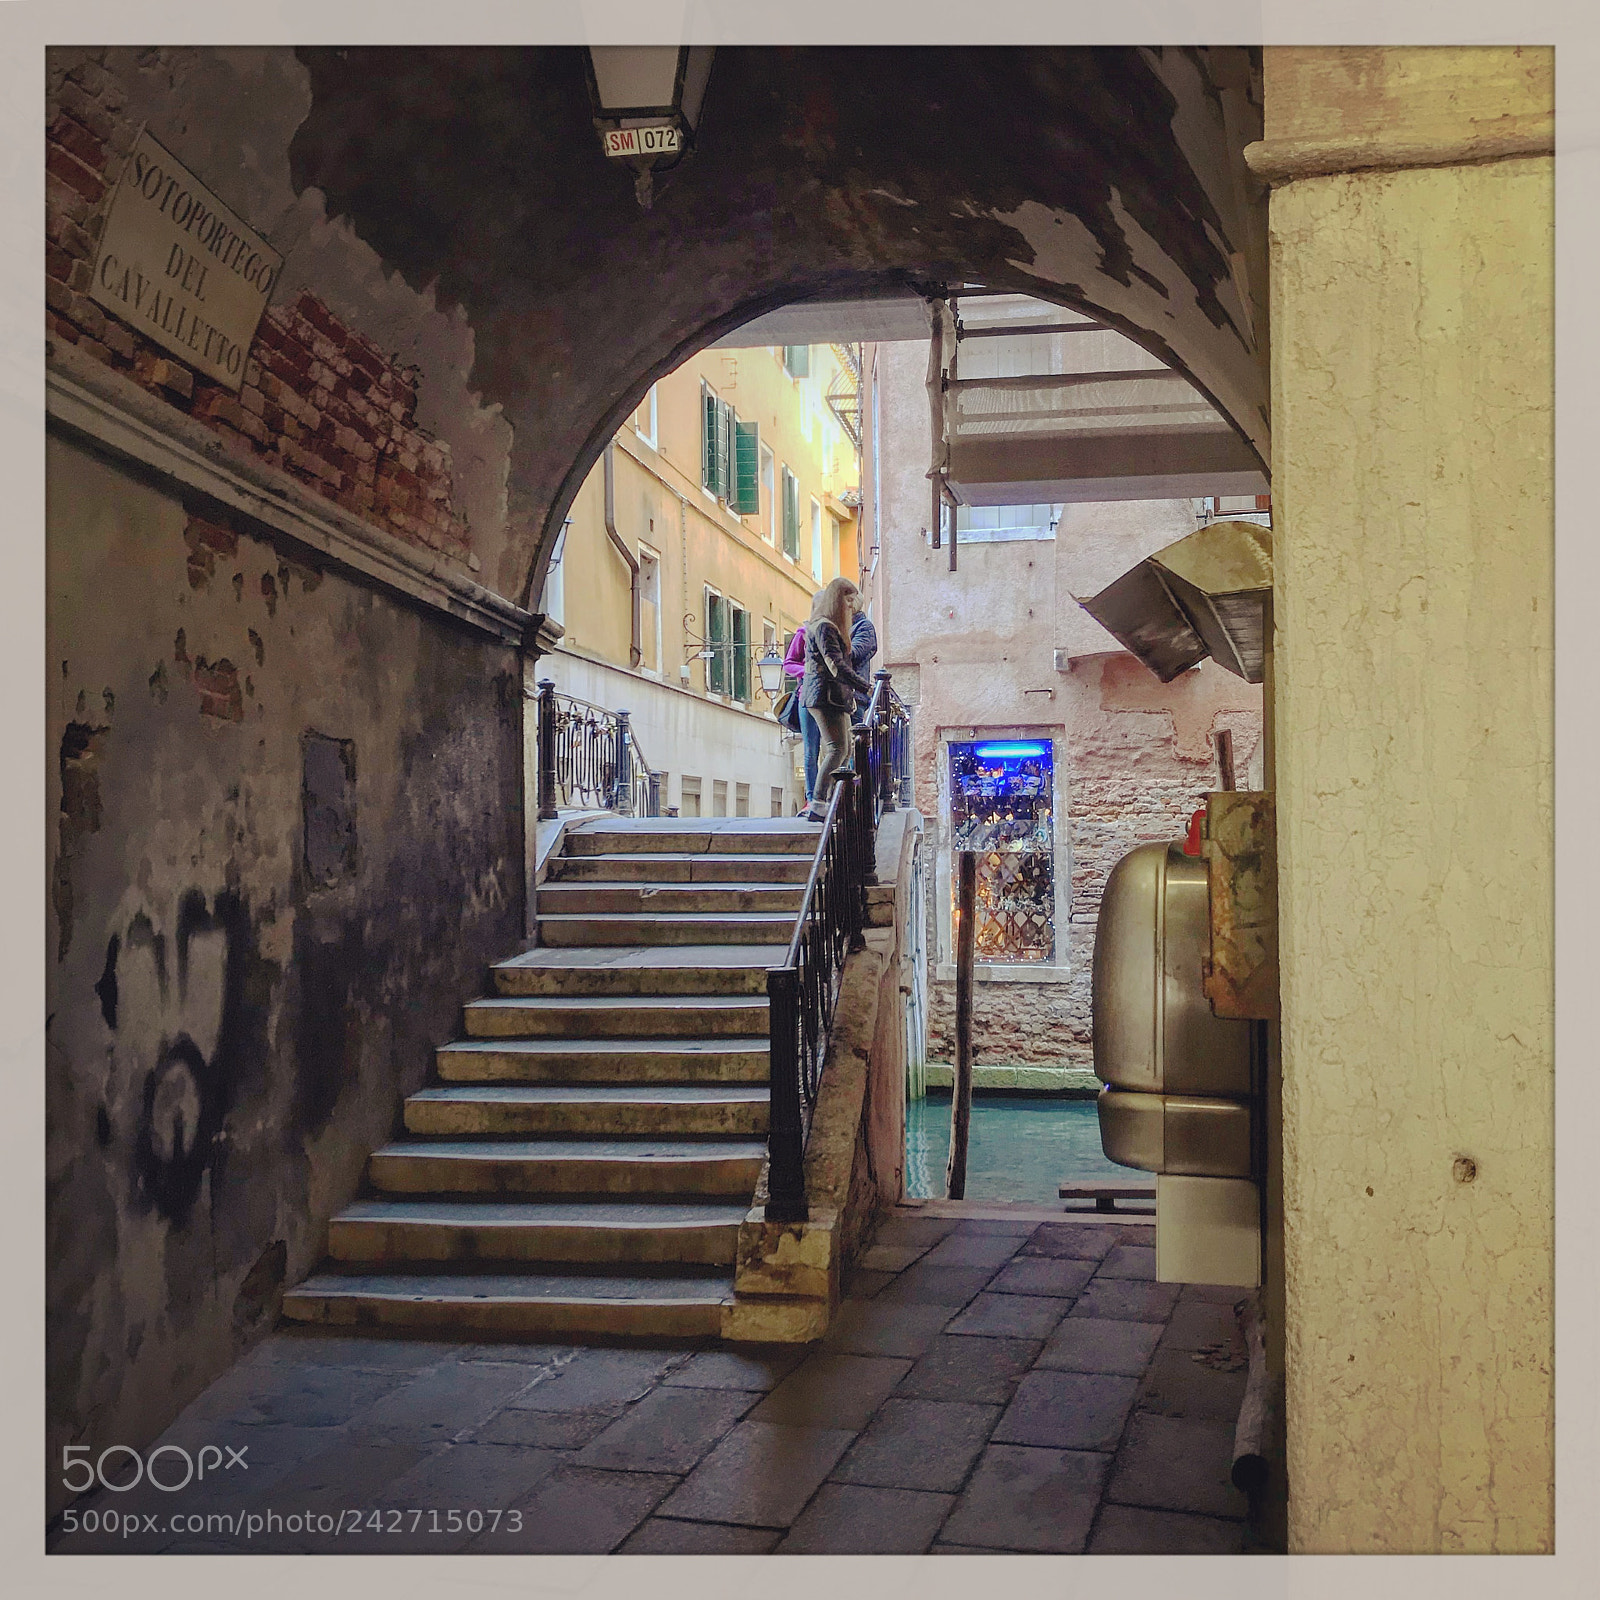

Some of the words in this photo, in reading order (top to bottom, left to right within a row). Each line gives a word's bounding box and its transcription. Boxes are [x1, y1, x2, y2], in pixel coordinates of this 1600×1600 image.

[610, 133, 634, 151] SM
[645, 130, 675, 148] 072
[128, 152, 275, 295] SOTOPORTEGO
[100, 254, 241, 375] CAVALLETTO
[164, 243, 209, 301] DEL
